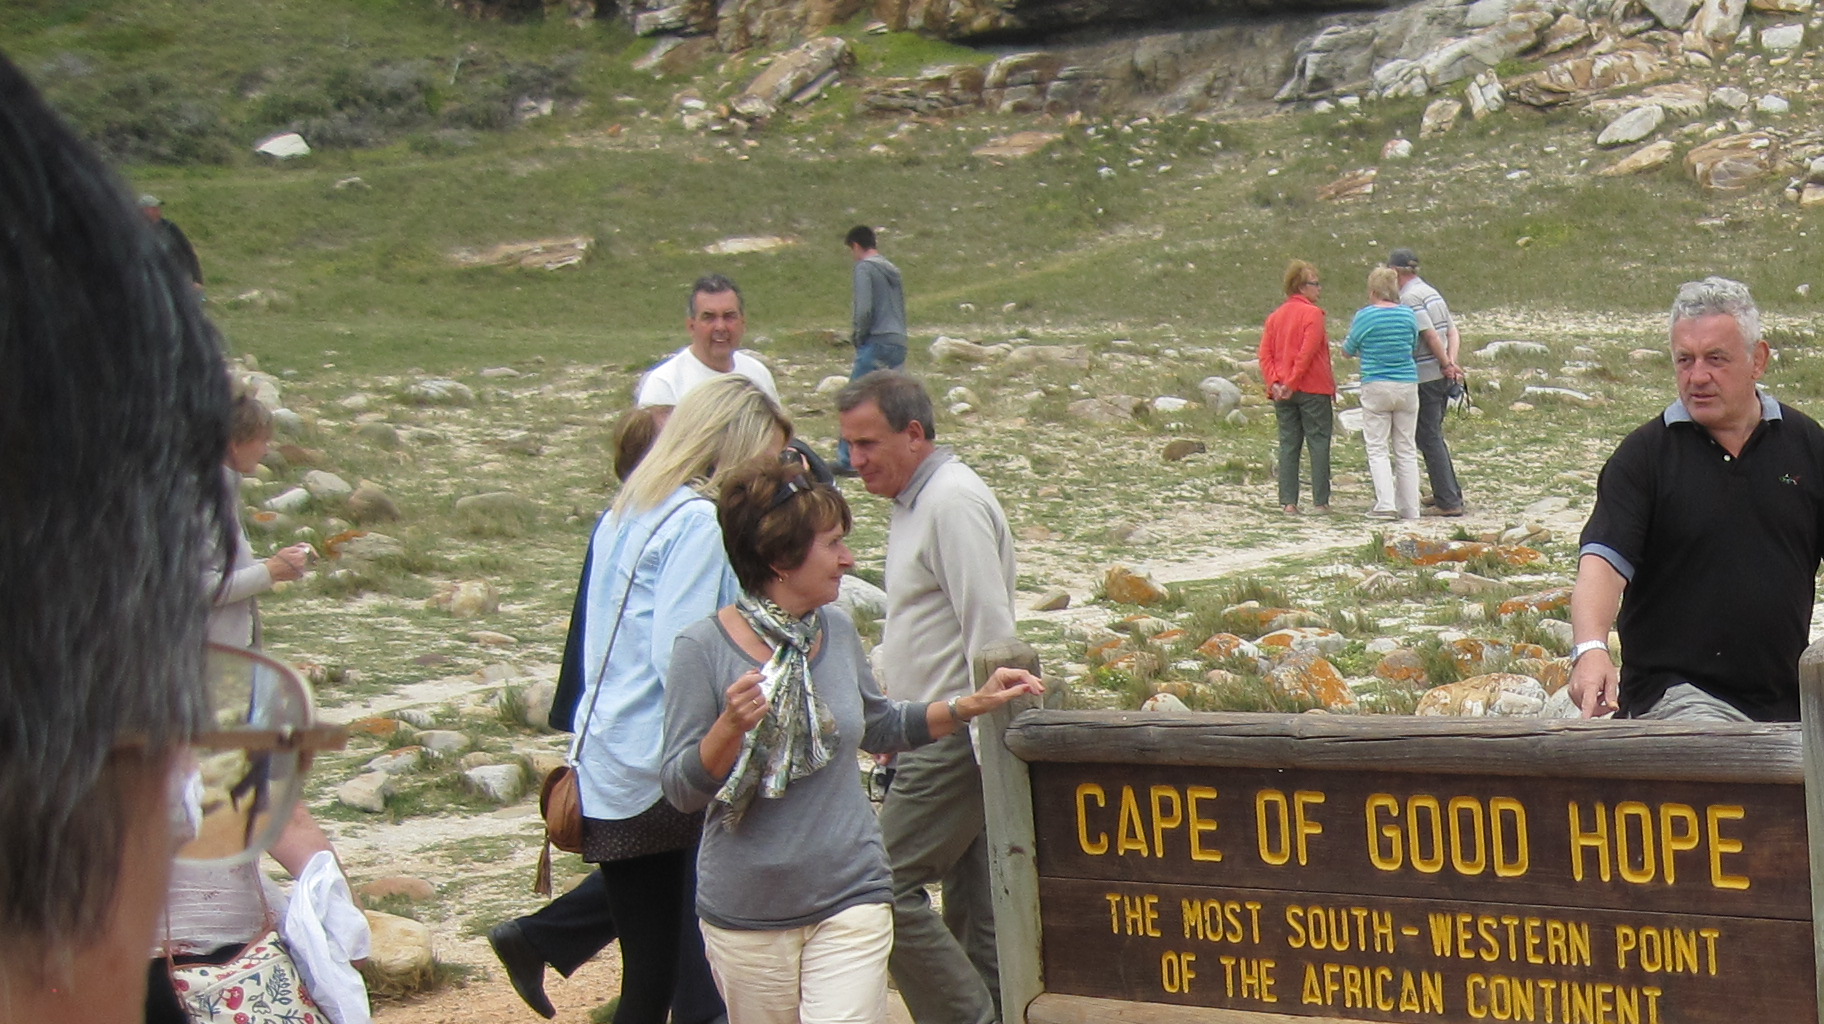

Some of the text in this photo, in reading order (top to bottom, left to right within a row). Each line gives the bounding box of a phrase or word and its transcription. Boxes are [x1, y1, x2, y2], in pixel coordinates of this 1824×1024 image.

[1074, 781, 1751, 890] CAPE OF GOOD HOPE
[1105, 892, 1721, 976] THE MOST SOUTH-WESTERN POINT
[1160, 950, 1197, 994] OF
[1220, 957, 1277, 1003] THE
[1301, 962, 1444, 1014] AFRICAN
